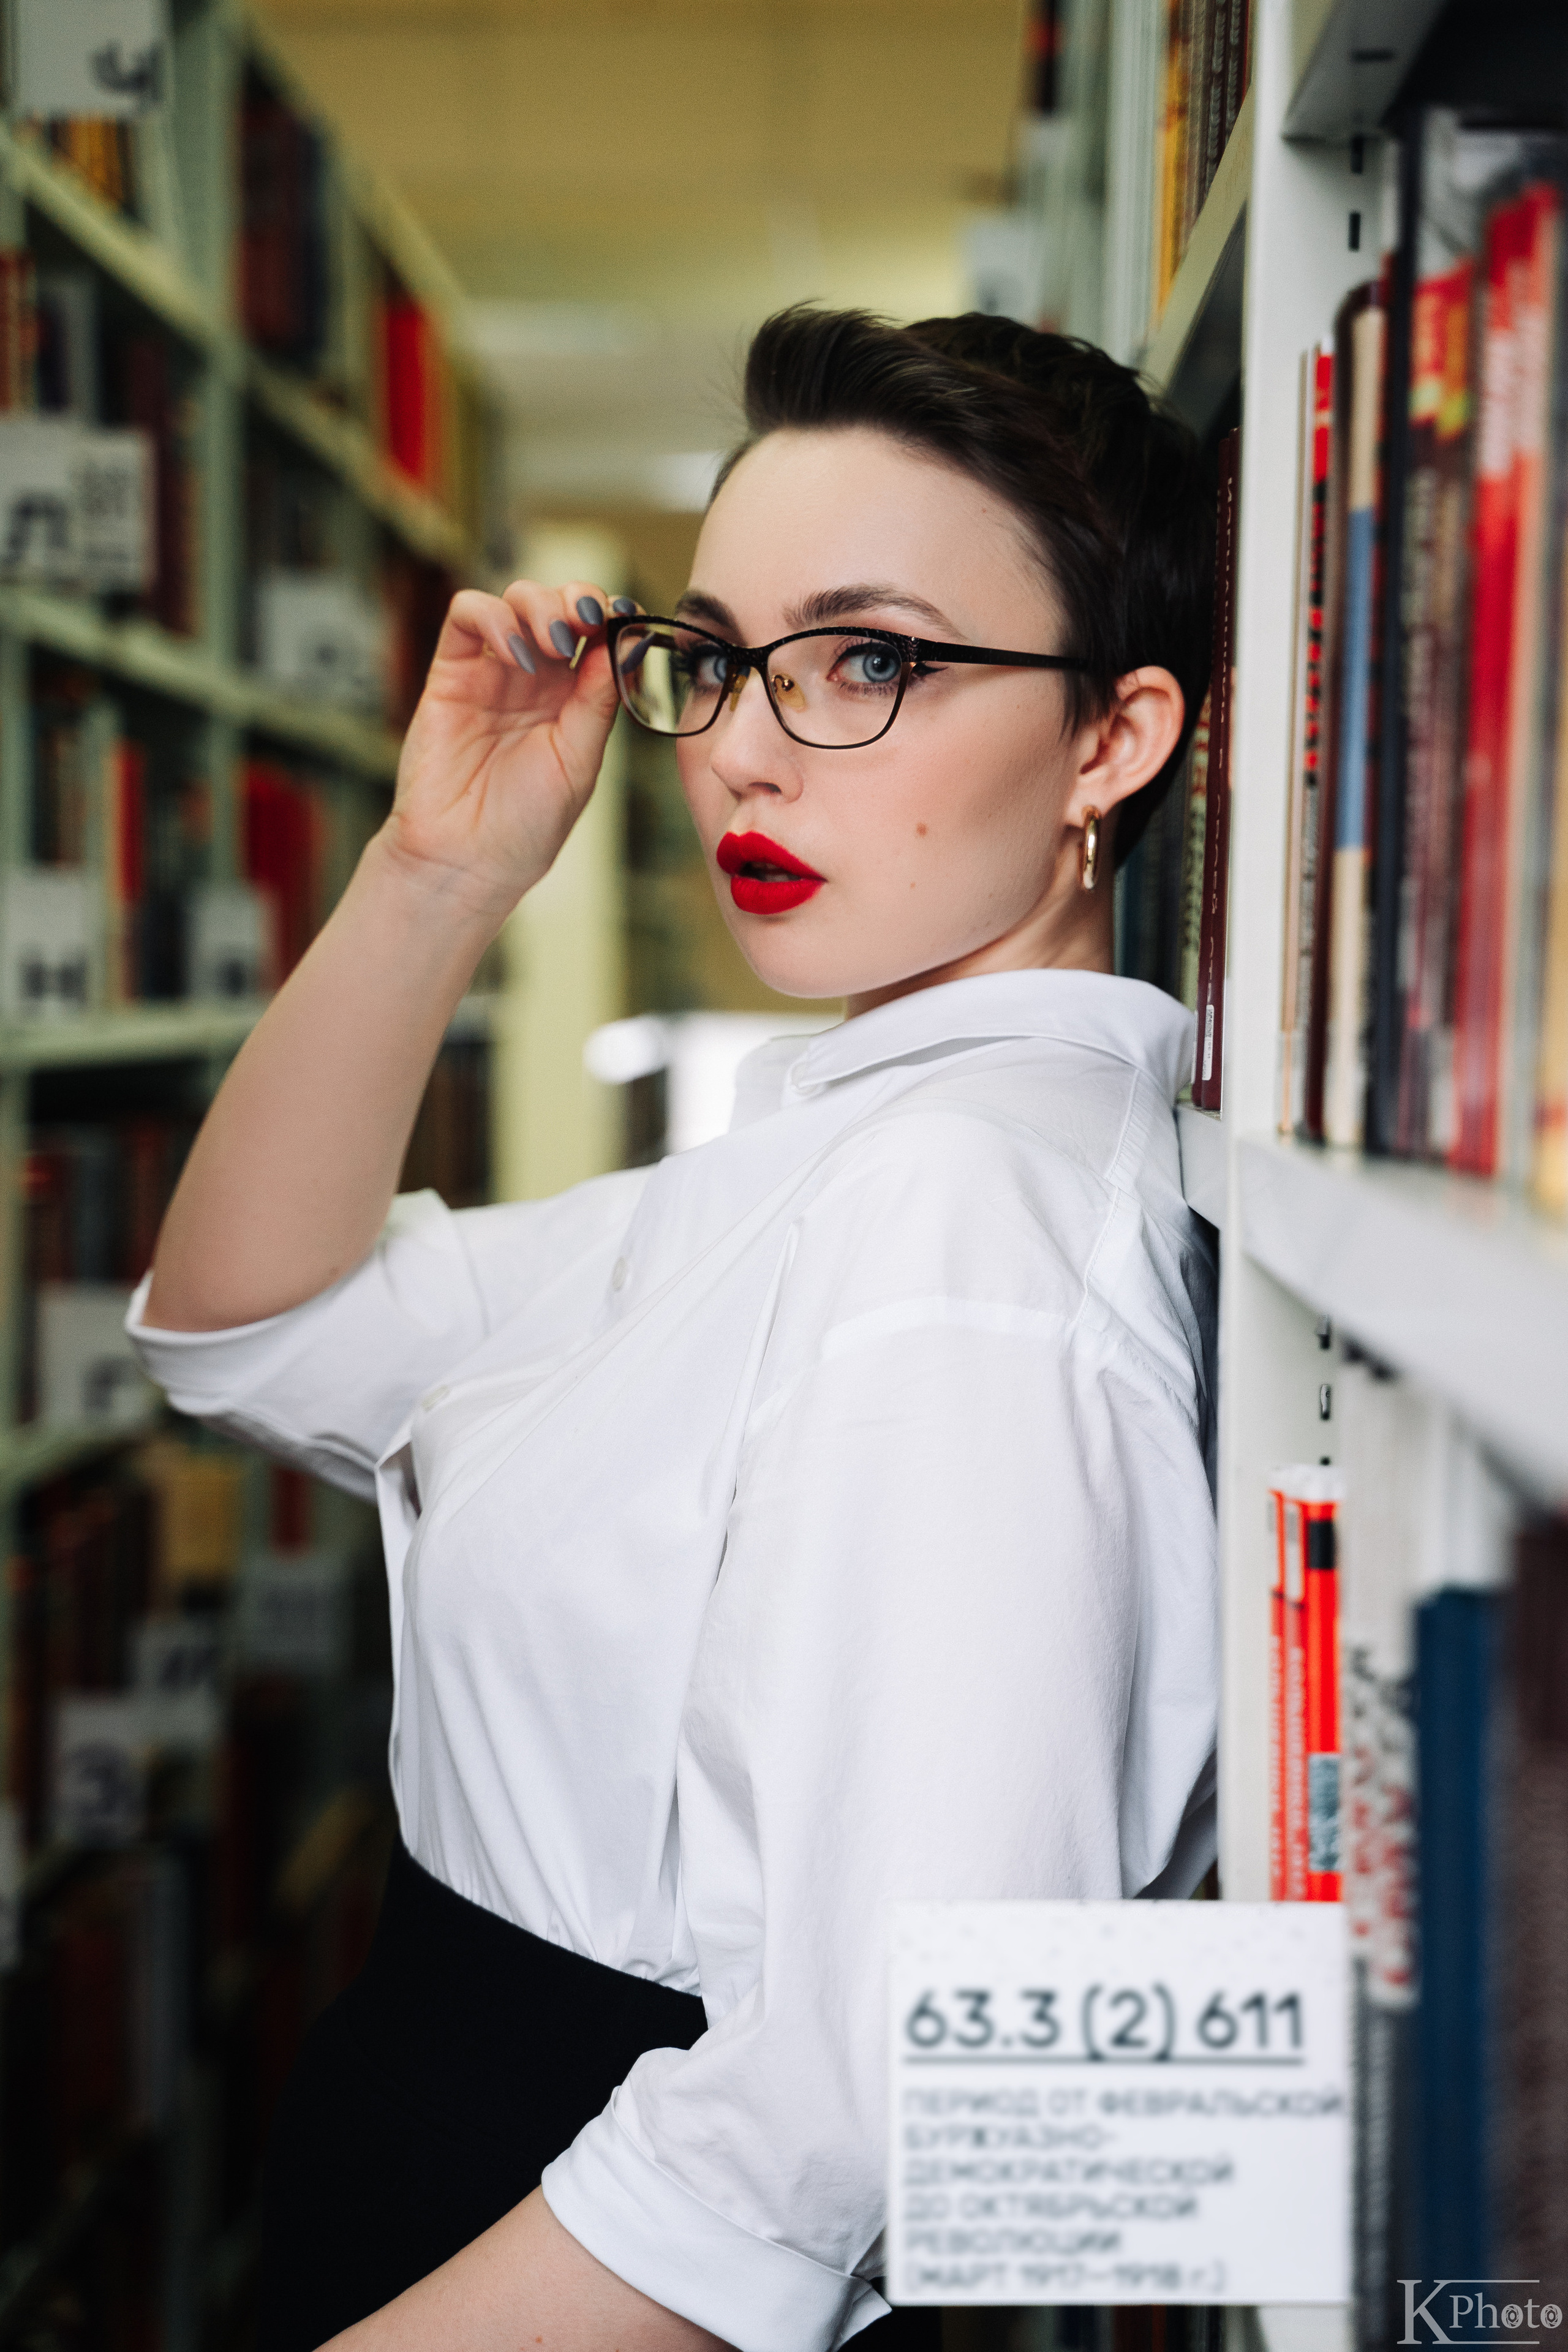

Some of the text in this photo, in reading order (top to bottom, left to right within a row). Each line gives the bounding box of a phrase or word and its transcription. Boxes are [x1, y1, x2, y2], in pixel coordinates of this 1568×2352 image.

[905, 1983, 1303, 2062] 63.3 (2) 611
[903, 2084, 1343, 2117] ПЕРИОД ОТ ФЕВРАЛЬСКОЙ
[903, 2125, 1118, 2150] БУРЖУАЗНО-
[903, 2154, 1234, 2185] ДЕМОКРАТИЧЕСКОЙ
[903, 2189, 1198, 2222] ДО ОКТЯБРЬСКОЙ
[904, 2230, 1121, 2256] РЕВОЛЮЦИИ
